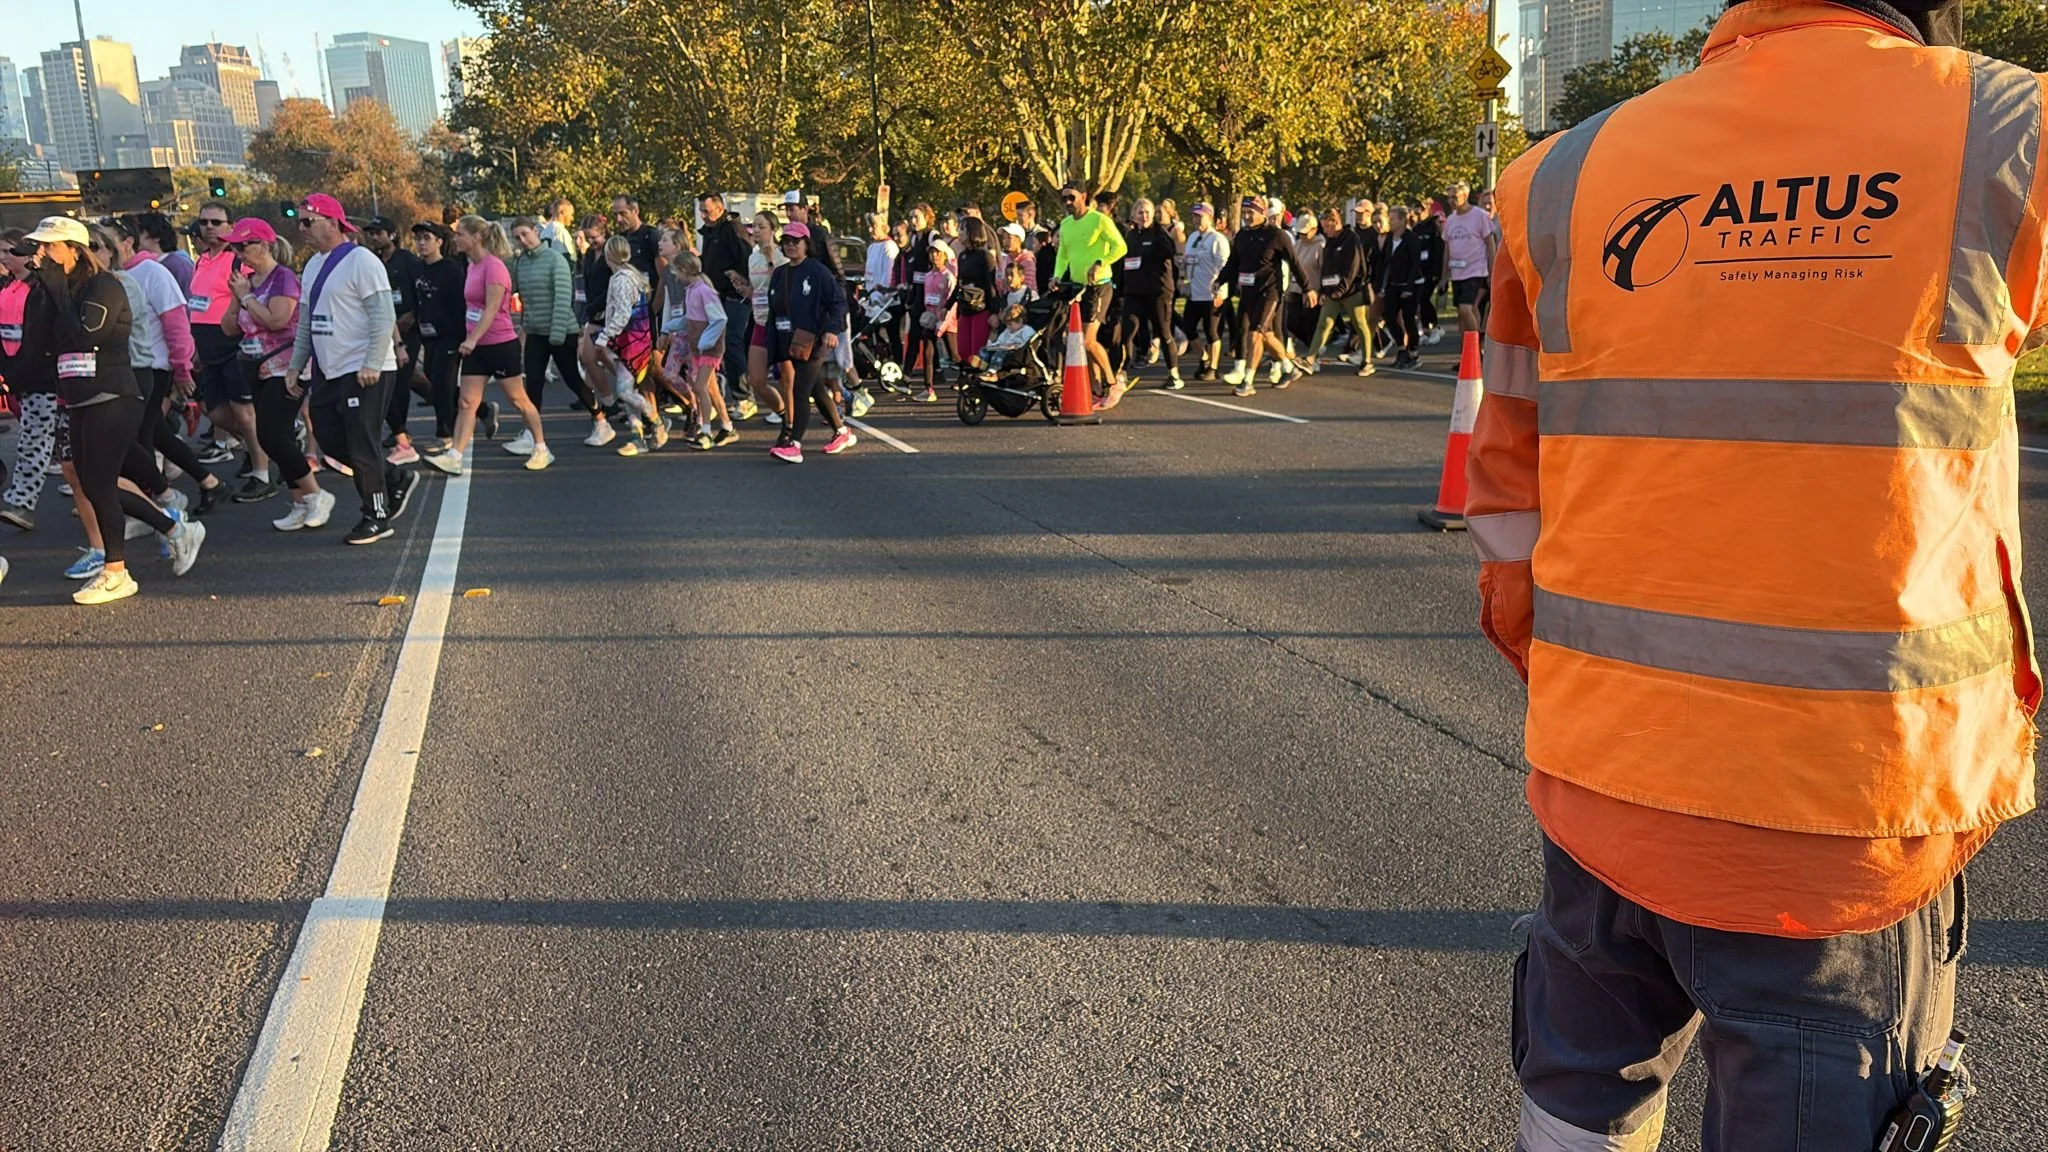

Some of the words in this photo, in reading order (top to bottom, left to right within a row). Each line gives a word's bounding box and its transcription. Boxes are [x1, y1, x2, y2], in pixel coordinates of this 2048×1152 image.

[1699, 171, 1902, 227] ALTUS
[1718, 224, 1872, 249] TRAFFIC
[1719, 271, 1759, 282] Safely
[1764, 270, 1828, 281] Managing
[1834, 268, 1864, 279] Risk
